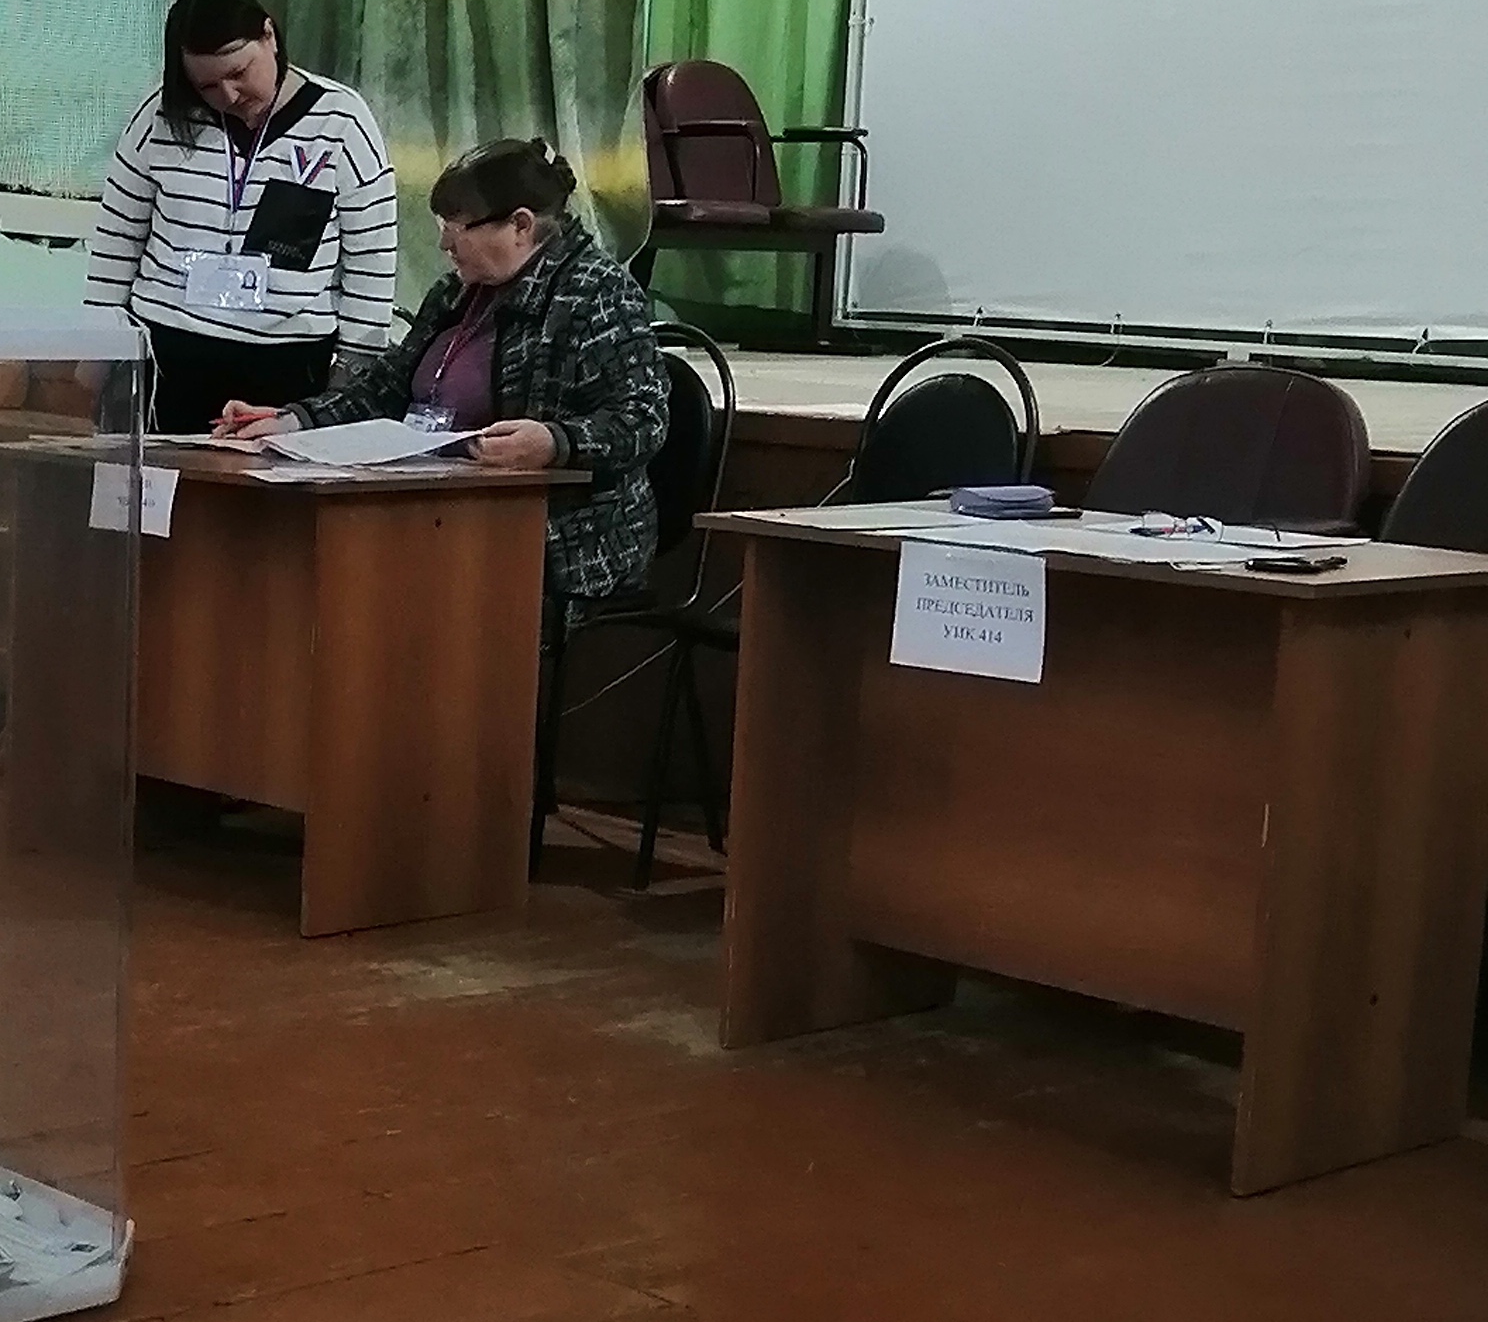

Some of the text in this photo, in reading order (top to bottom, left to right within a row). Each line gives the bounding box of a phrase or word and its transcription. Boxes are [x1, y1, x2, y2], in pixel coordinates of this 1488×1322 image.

[924, 573, 1030, 597] ЗАМЕСТИТЕЛЬ
[916, 597, 1034, 622] ПРЕДСЕДАТЕЛЯ
[943, 624, 1003, 643] УИК 414
